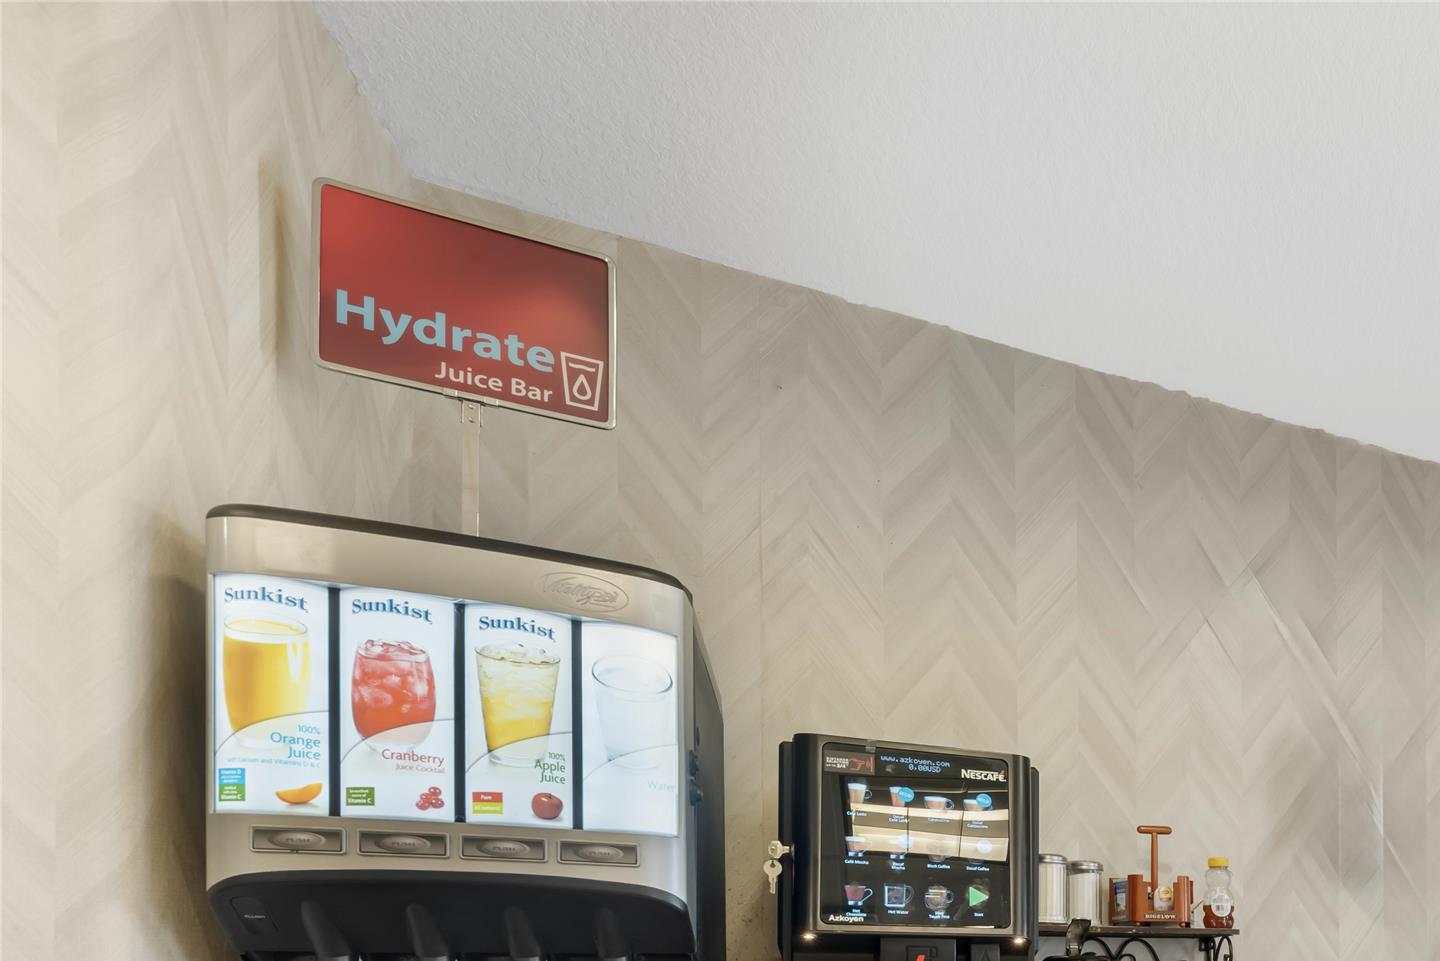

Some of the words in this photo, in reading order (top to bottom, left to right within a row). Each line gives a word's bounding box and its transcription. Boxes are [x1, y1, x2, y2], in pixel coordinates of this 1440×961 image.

[336, 288, 555, 373] Hydrate
[434, 361, 503, 392] Juice
[511, 377, 553, 403] Bar
[224, 586, 308, 612] Sunkist
[352, 599, 432, 624] Sunkist
[479, 616, 555, 641] Sunkist
[298, 724, 320, 735] 100%
[270, 732, 321, 749] Orange
[287, 746, 321, 760] Juice
[381, 748, 445, 767] Cranberry
[548, 752, 566, 761] 100%
[534, 759, 566, 774] Apple
[539, 771, 566, 784] Juice
[829, 914, 864, 923] Azkoyen
